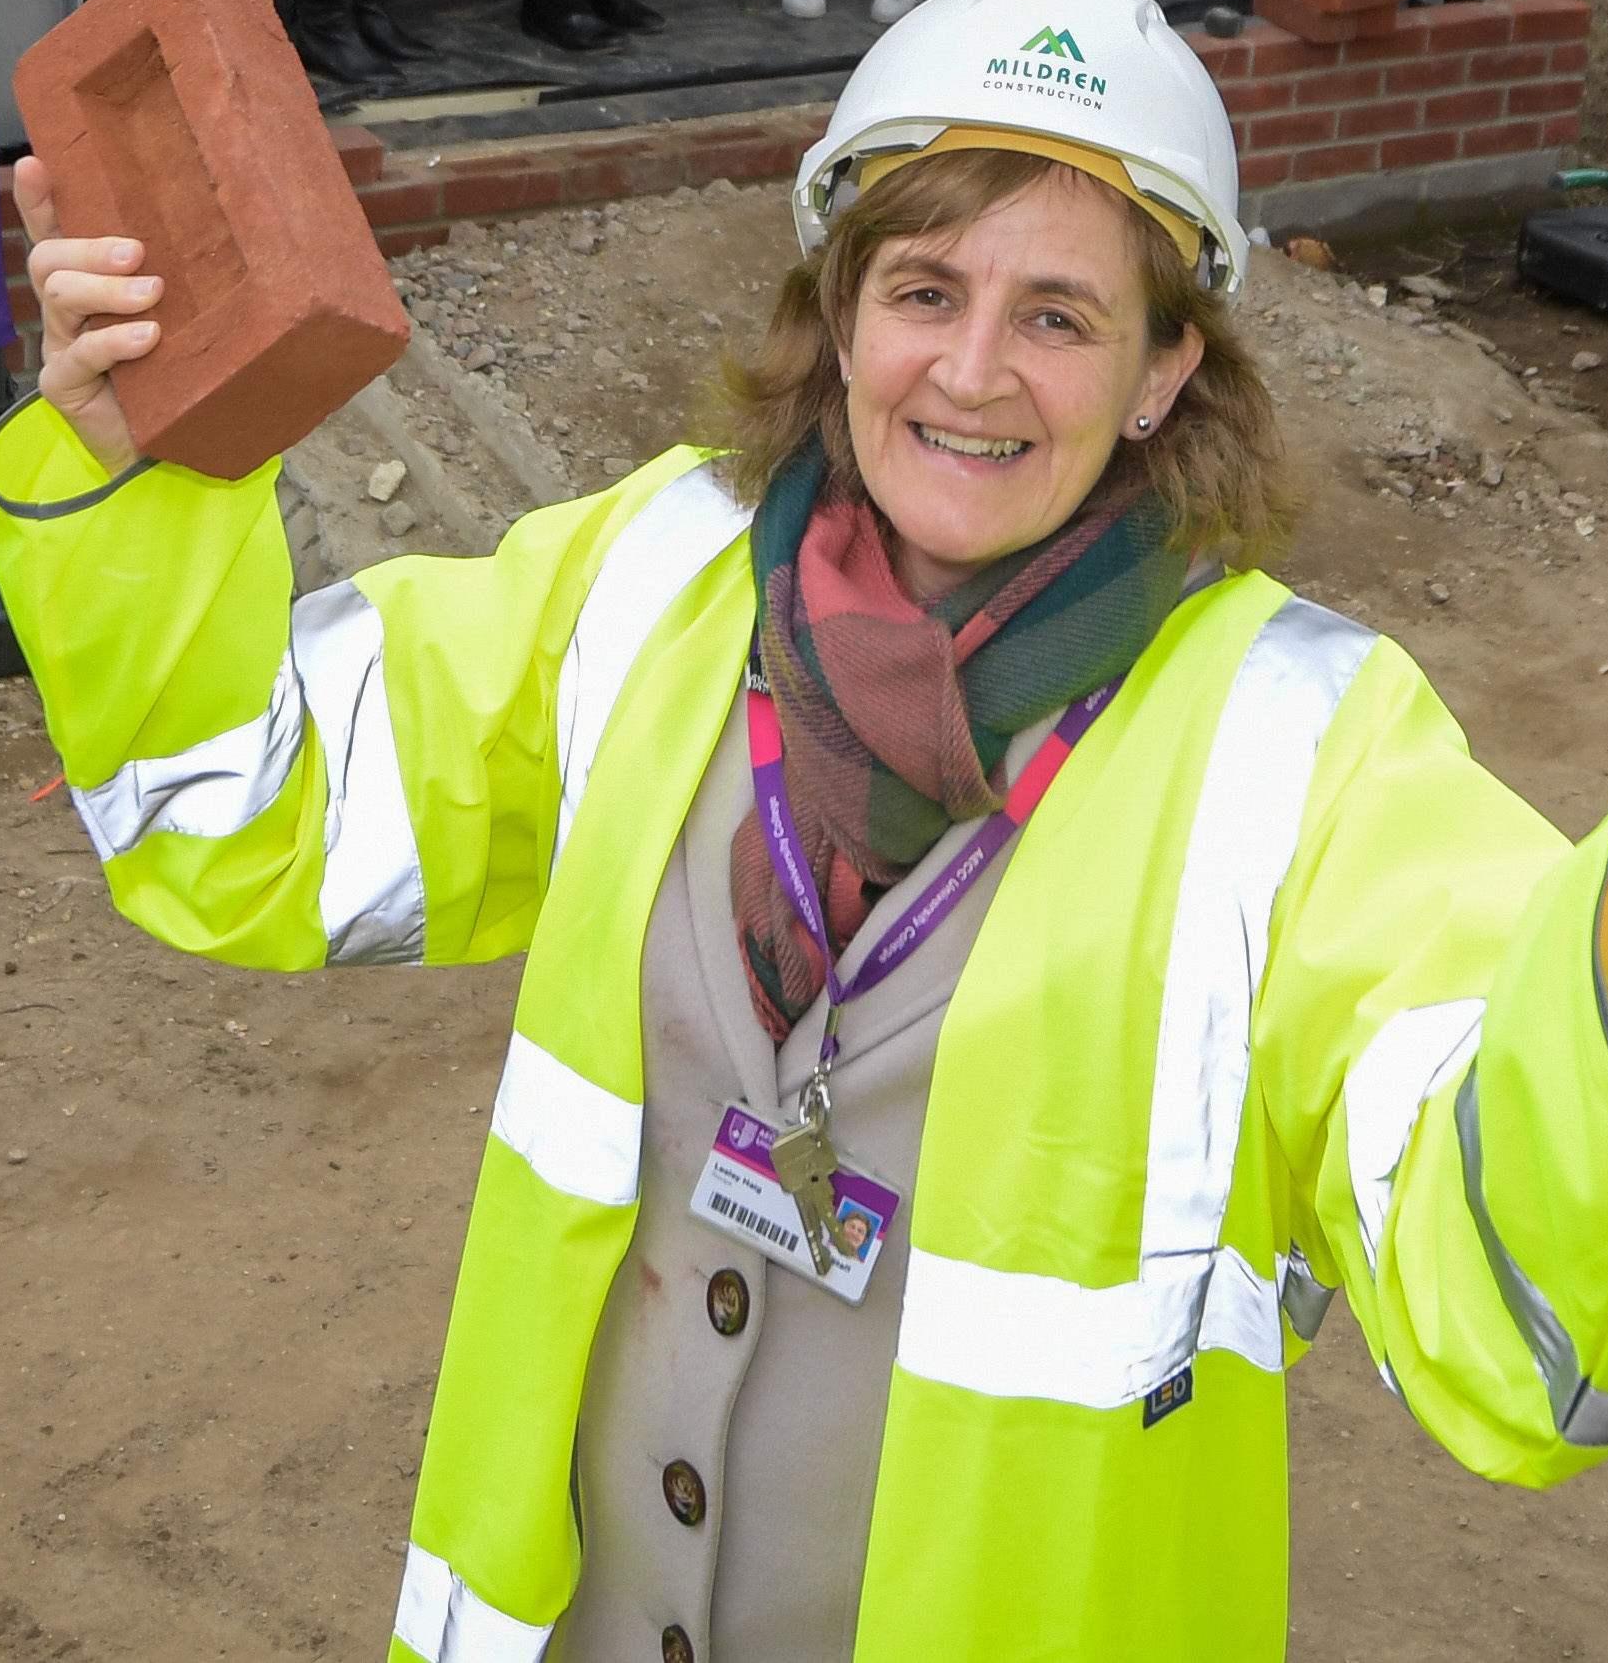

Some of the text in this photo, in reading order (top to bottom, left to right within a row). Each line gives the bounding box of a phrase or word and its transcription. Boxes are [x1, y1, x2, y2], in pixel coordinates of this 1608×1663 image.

[983, 80, 1104, 111] CONSTRUCTION
[986, 58, 1107, 96] MILDREN
[1151, 1375, 1187, 1414] LEO
